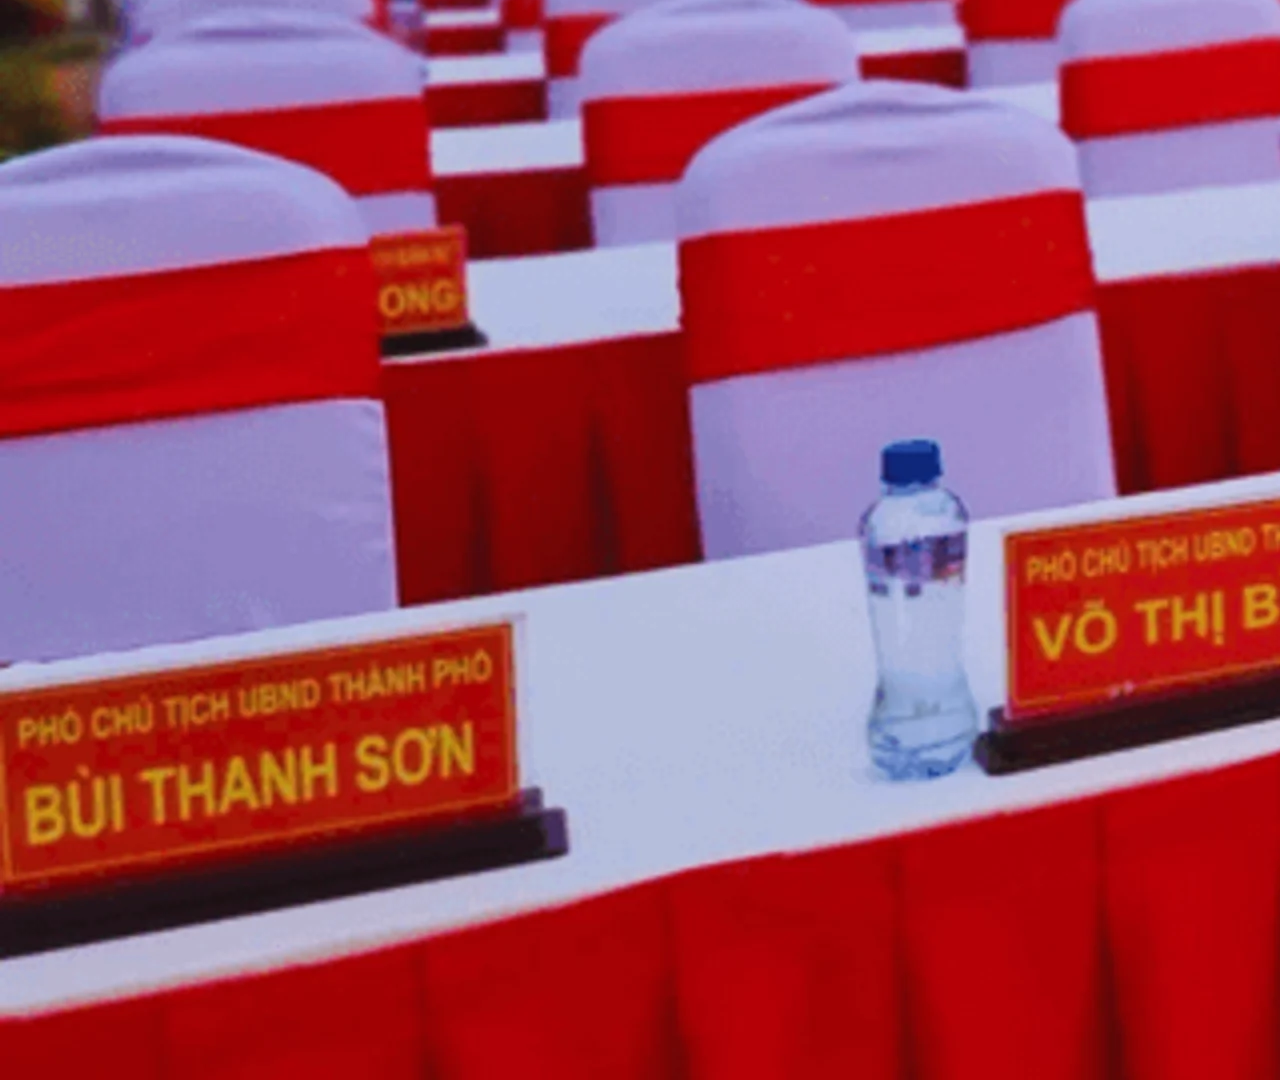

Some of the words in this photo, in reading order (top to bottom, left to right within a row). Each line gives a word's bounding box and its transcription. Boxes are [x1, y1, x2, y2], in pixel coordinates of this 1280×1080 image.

[378, 279, 458, 318] ONG
[1192, 526, 1256, 562] UBND
[1032, 599, 1118, 661] VÕ
[1135, 590, 1225, 646] THỊ
[238, 678, 322, 718] UBND
[25, 763, 124, 846] BÙI
[140, 743, 338, 824] THANH
[355, 723, 475, 792] SƠN
